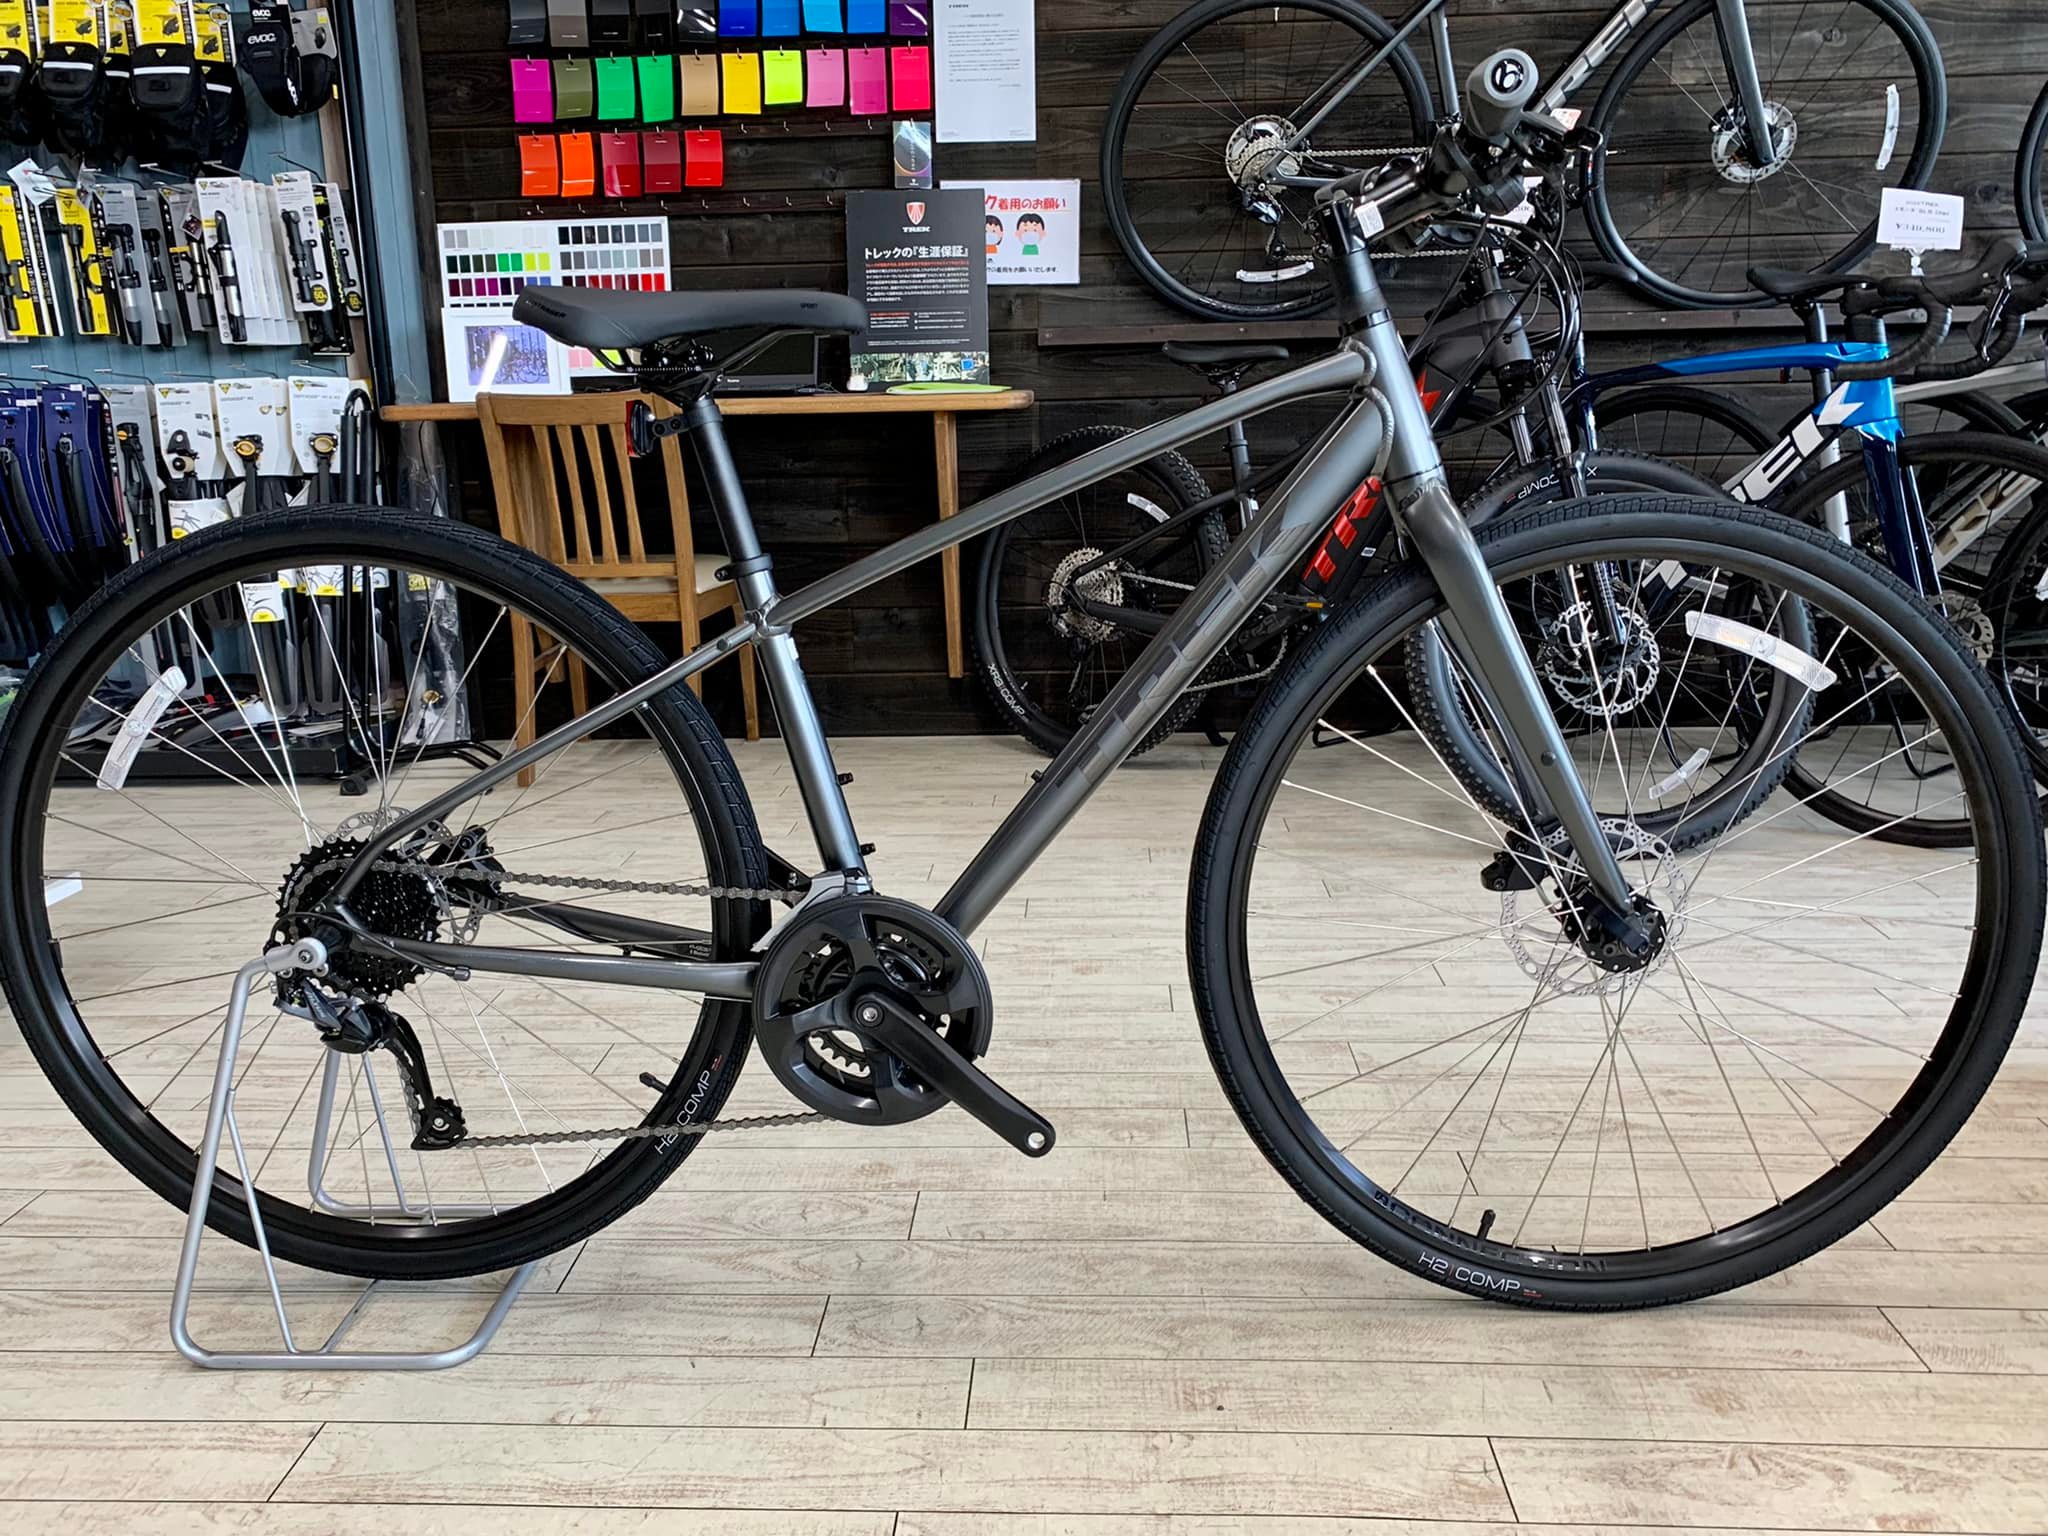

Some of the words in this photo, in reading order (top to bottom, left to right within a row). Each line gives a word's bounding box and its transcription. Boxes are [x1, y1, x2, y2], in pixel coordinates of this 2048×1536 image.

[1000, 687, 1025, 715] COMP
[676, 1069, 711, 1126] COMP
[1417, 1250, 1449, 1275] H2
[1453, 1266, 1521, 1293] COMP
